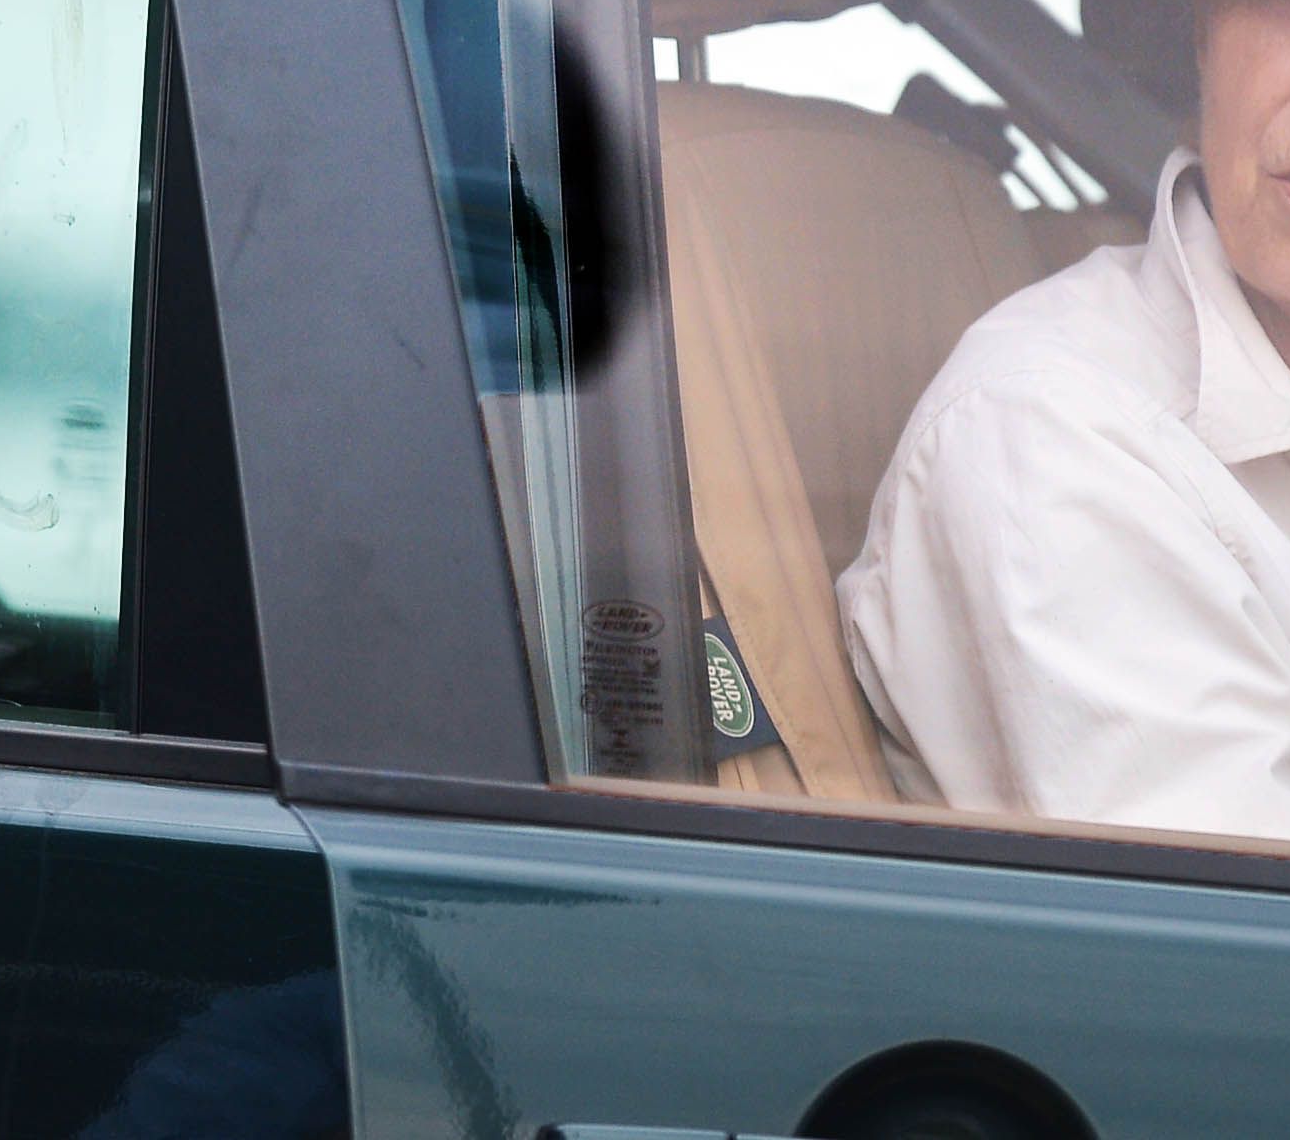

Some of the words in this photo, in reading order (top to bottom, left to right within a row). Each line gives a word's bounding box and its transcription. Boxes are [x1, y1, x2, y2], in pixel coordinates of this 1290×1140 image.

[596, 607, 640, 619] LAND
[602, 620, 653, 633] ROVER
[712, 656, 743, 703] LAND
